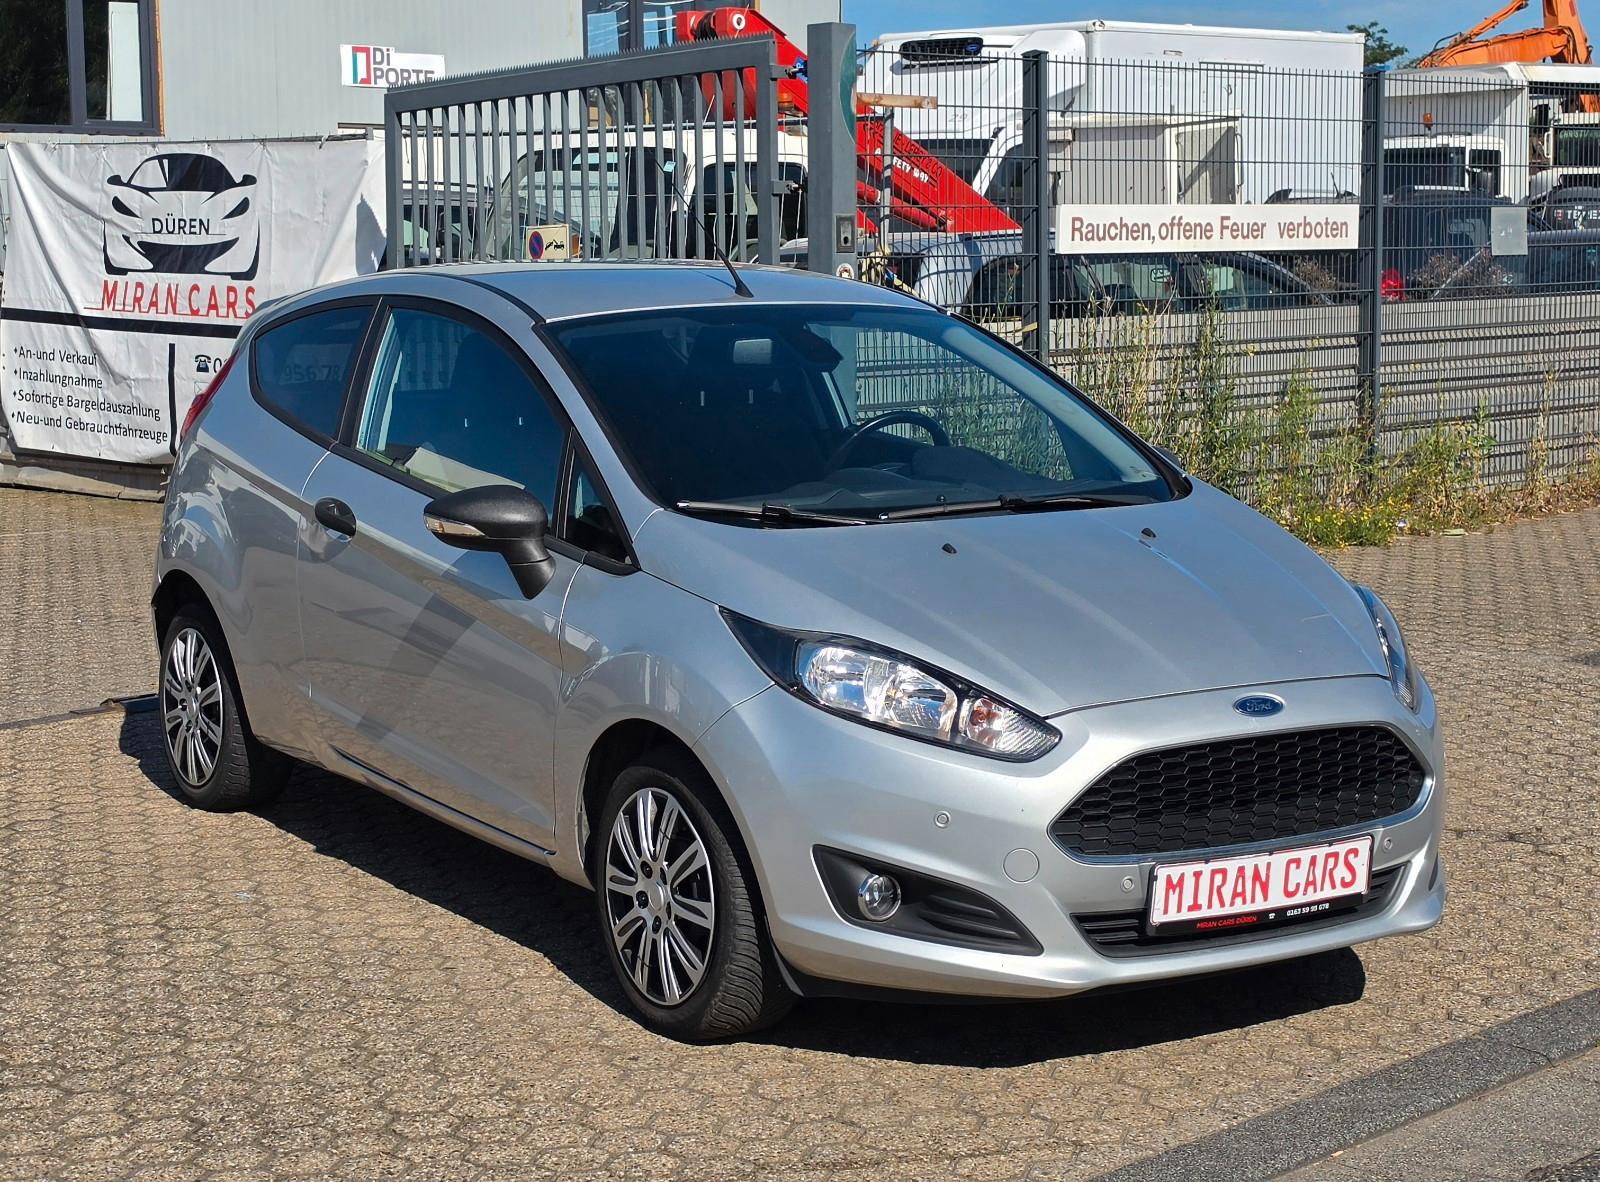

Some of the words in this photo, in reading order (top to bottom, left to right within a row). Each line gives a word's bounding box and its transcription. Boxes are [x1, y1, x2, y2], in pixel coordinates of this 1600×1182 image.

[372, 47, 391, 67] Di
[151, 213, 210, 235] DÜREN
[1219, 215, 1267, 240] Feuer
[1277, 215, 1349, 239] verboten
[103, 279, 179, 316] MIRAN
[188, 283, 256, 320] CARS
[18, 345, 55, 362] An-und
[59, 350, 98, 366] Verkauf
[19, 367, 103, 389] Inzahlungnahme
[18, 389, 64, 408] Sofortige
[66, 394, 161, 422] Bargeldauszahlung
[16, 411, 62, 428] Neu-und
[65, 416, 168, 445] Gebrauchtfahrzeuge
[1162, 861, 1272, 916] MIRAN
[1282, 847, 1360, 899] CARS
